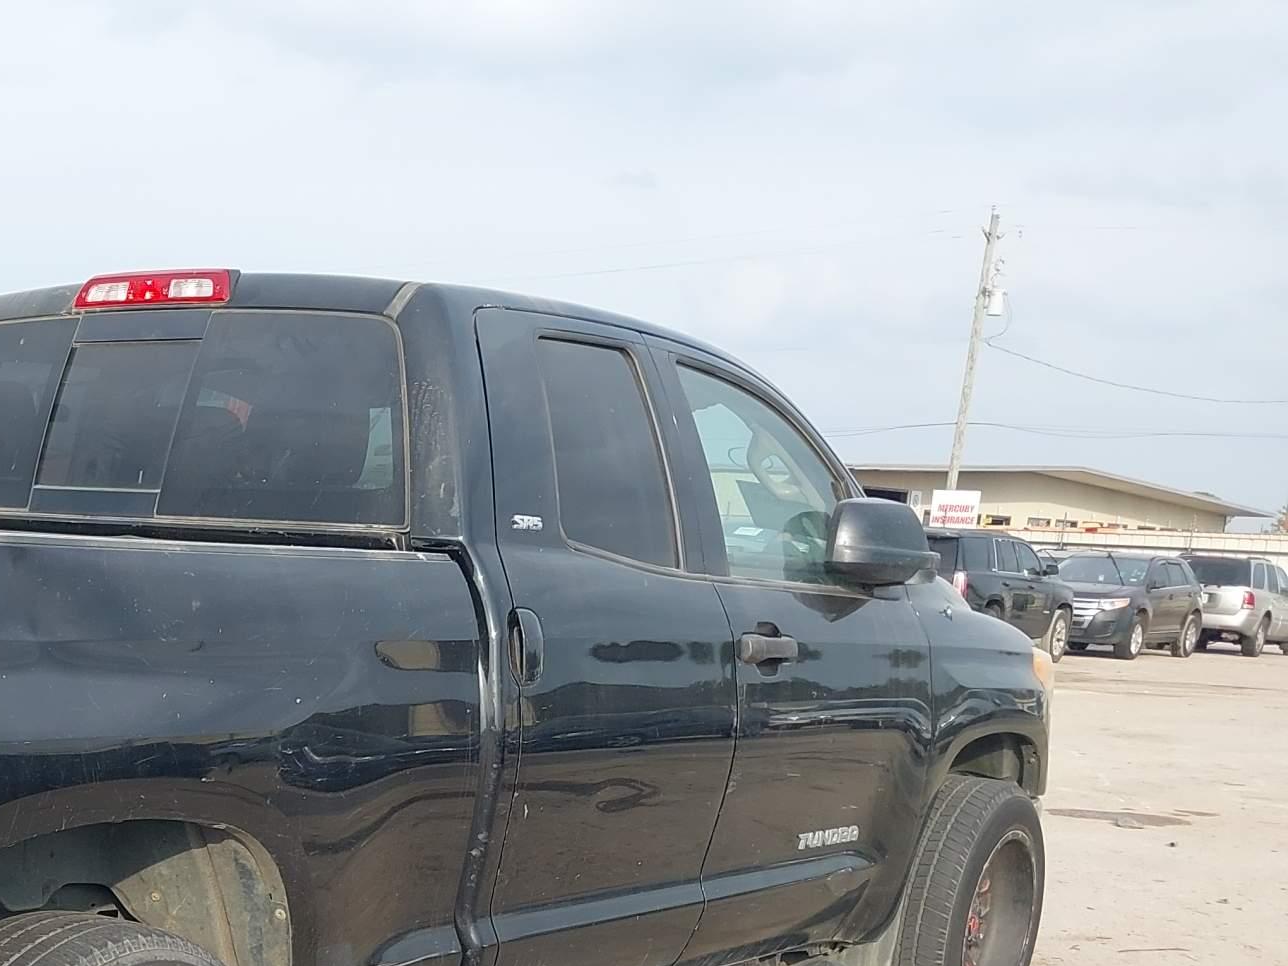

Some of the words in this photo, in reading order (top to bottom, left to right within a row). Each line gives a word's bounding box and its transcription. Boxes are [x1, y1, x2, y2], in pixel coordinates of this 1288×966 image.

[937, 503, 975, 513] MERCURY
[512, 514, 543, 531] SR5
[931, 514, 976, 525] INSURANCE
[797, 825, 860, 850] TUNDRA
